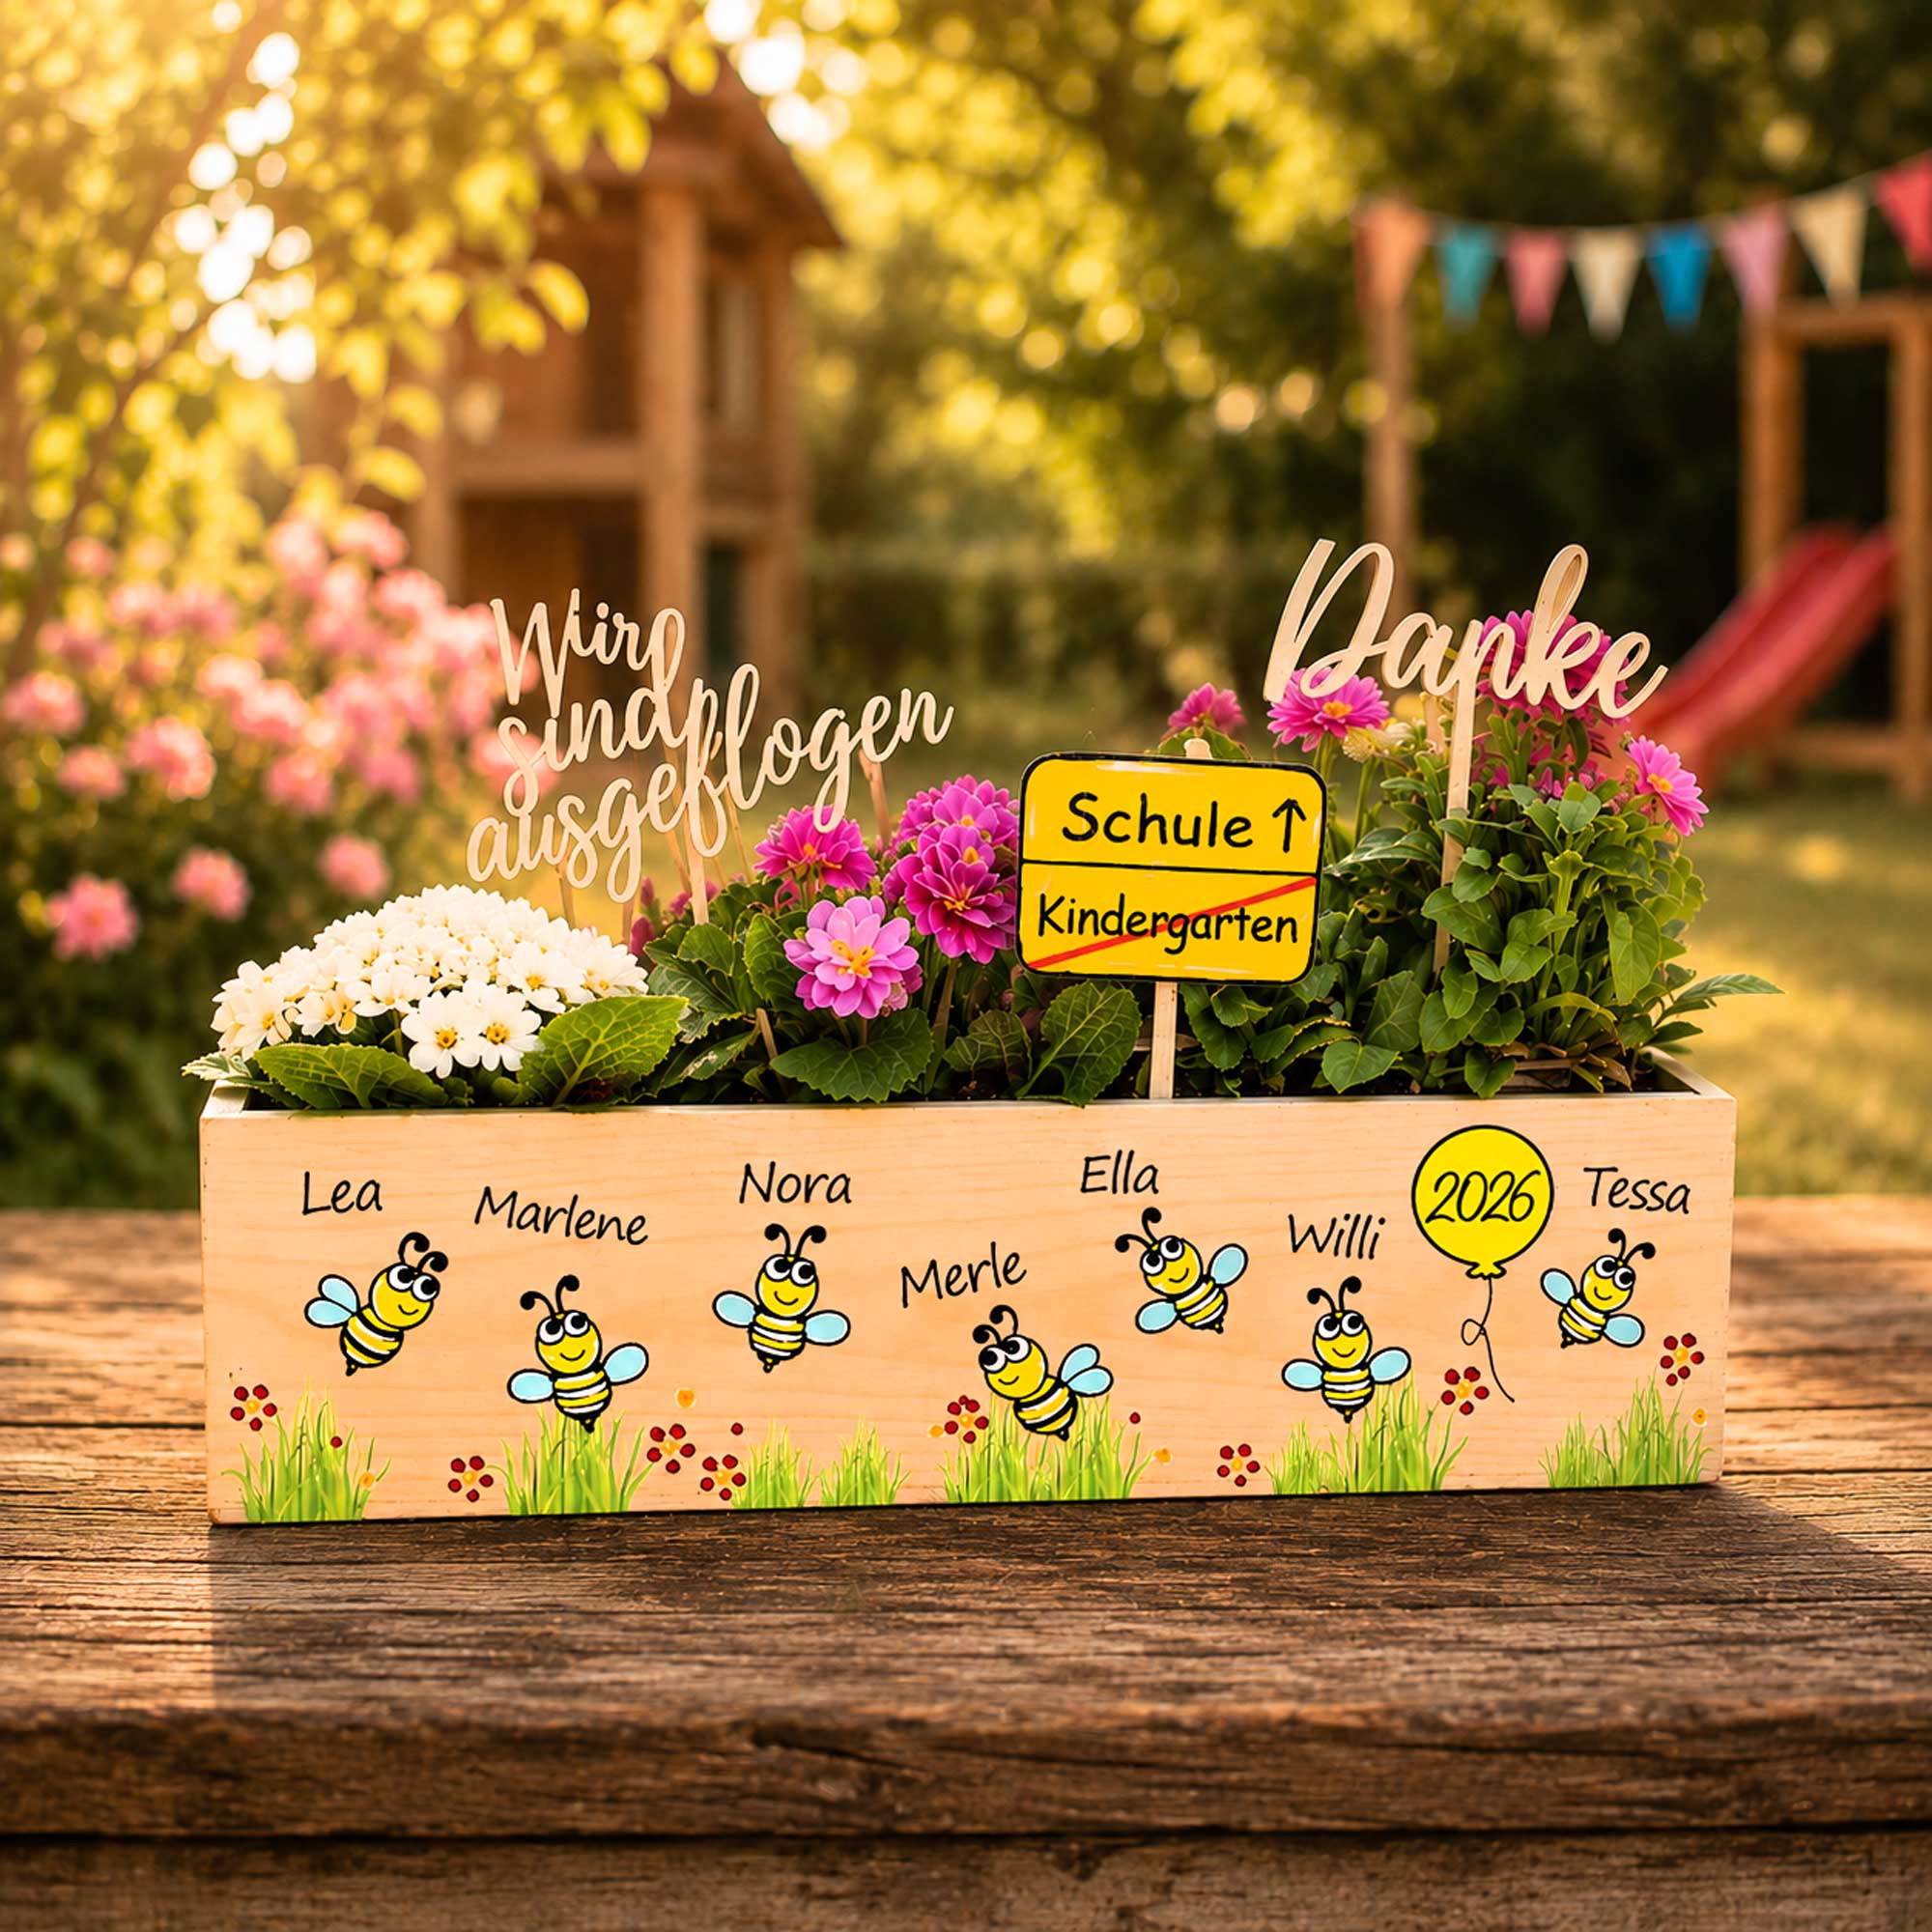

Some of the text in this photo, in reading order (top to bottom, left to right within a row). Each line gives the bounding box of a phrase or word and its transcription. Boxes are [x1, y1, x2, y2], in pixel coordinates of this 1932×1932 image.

[490, 588, 645, 718] Wir
[1264, 538, 1668, 719] Danke
[498, 609, 686, 816] sind
[467, 664, 954, 902] ausgeflogen
[1063, 792, 1254, 848] Schule
[1038, 893, 1299, 954] Kindergarten
[302, 1172, 384, 1216] Lea
[740, 1161, 852, 1205] Nora
[1081, 1151, 1159, 1195] Ella
[1425, 1169, 1543, 1225] 2026
[1584, 1167, 1690, 1215] Tessa
[474, 1186, 648, 1246] Marlene
[1289, 1214, 1386, 1261] Willi
[901, 1241, 1027, 1310] Merle
